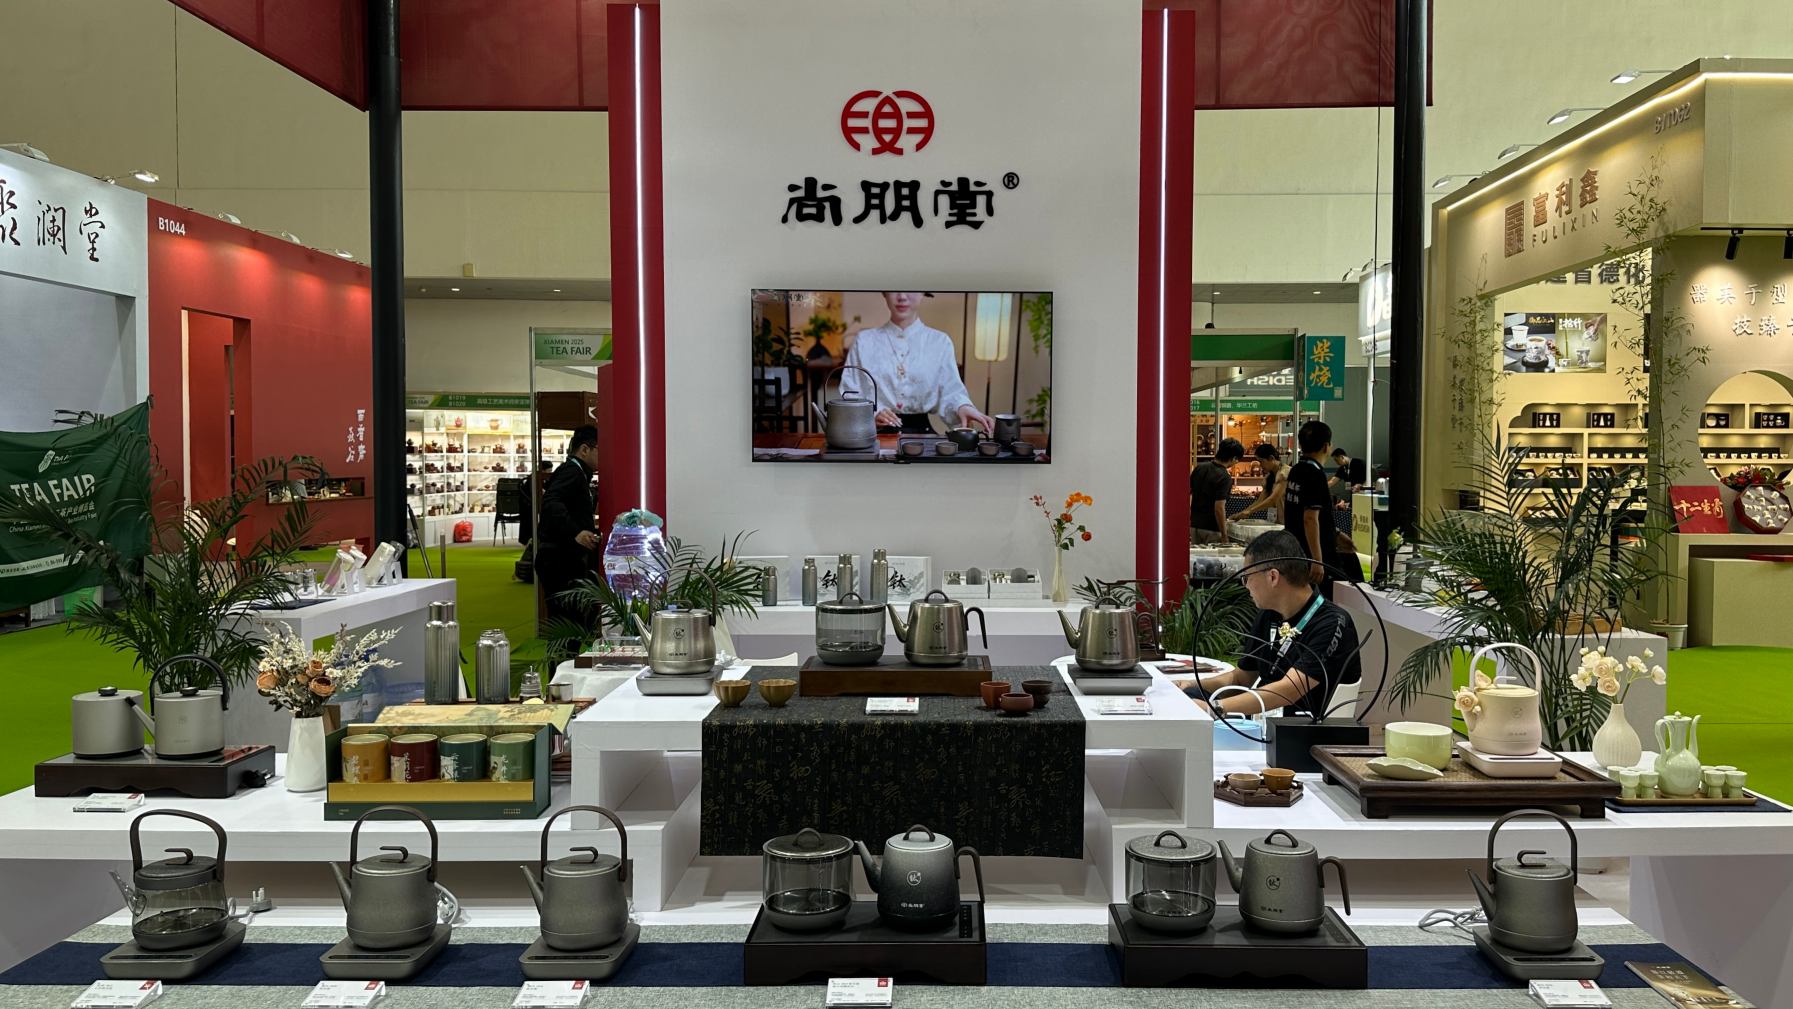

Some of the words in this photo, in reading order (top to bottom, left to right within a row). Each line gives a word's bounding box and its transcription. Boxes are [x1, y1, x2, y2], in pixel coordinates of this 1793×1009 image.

[781, 177, 994, 229] 尚朋堂
[1532, 168, 1601, 229] 富利鑫
[158, 216, 186, 236] B1044
[1531, 207, 1600, 249] FULIXIN
[550, 346, 568, 355] TEA
[570, 346, 592, 355] FAIR
